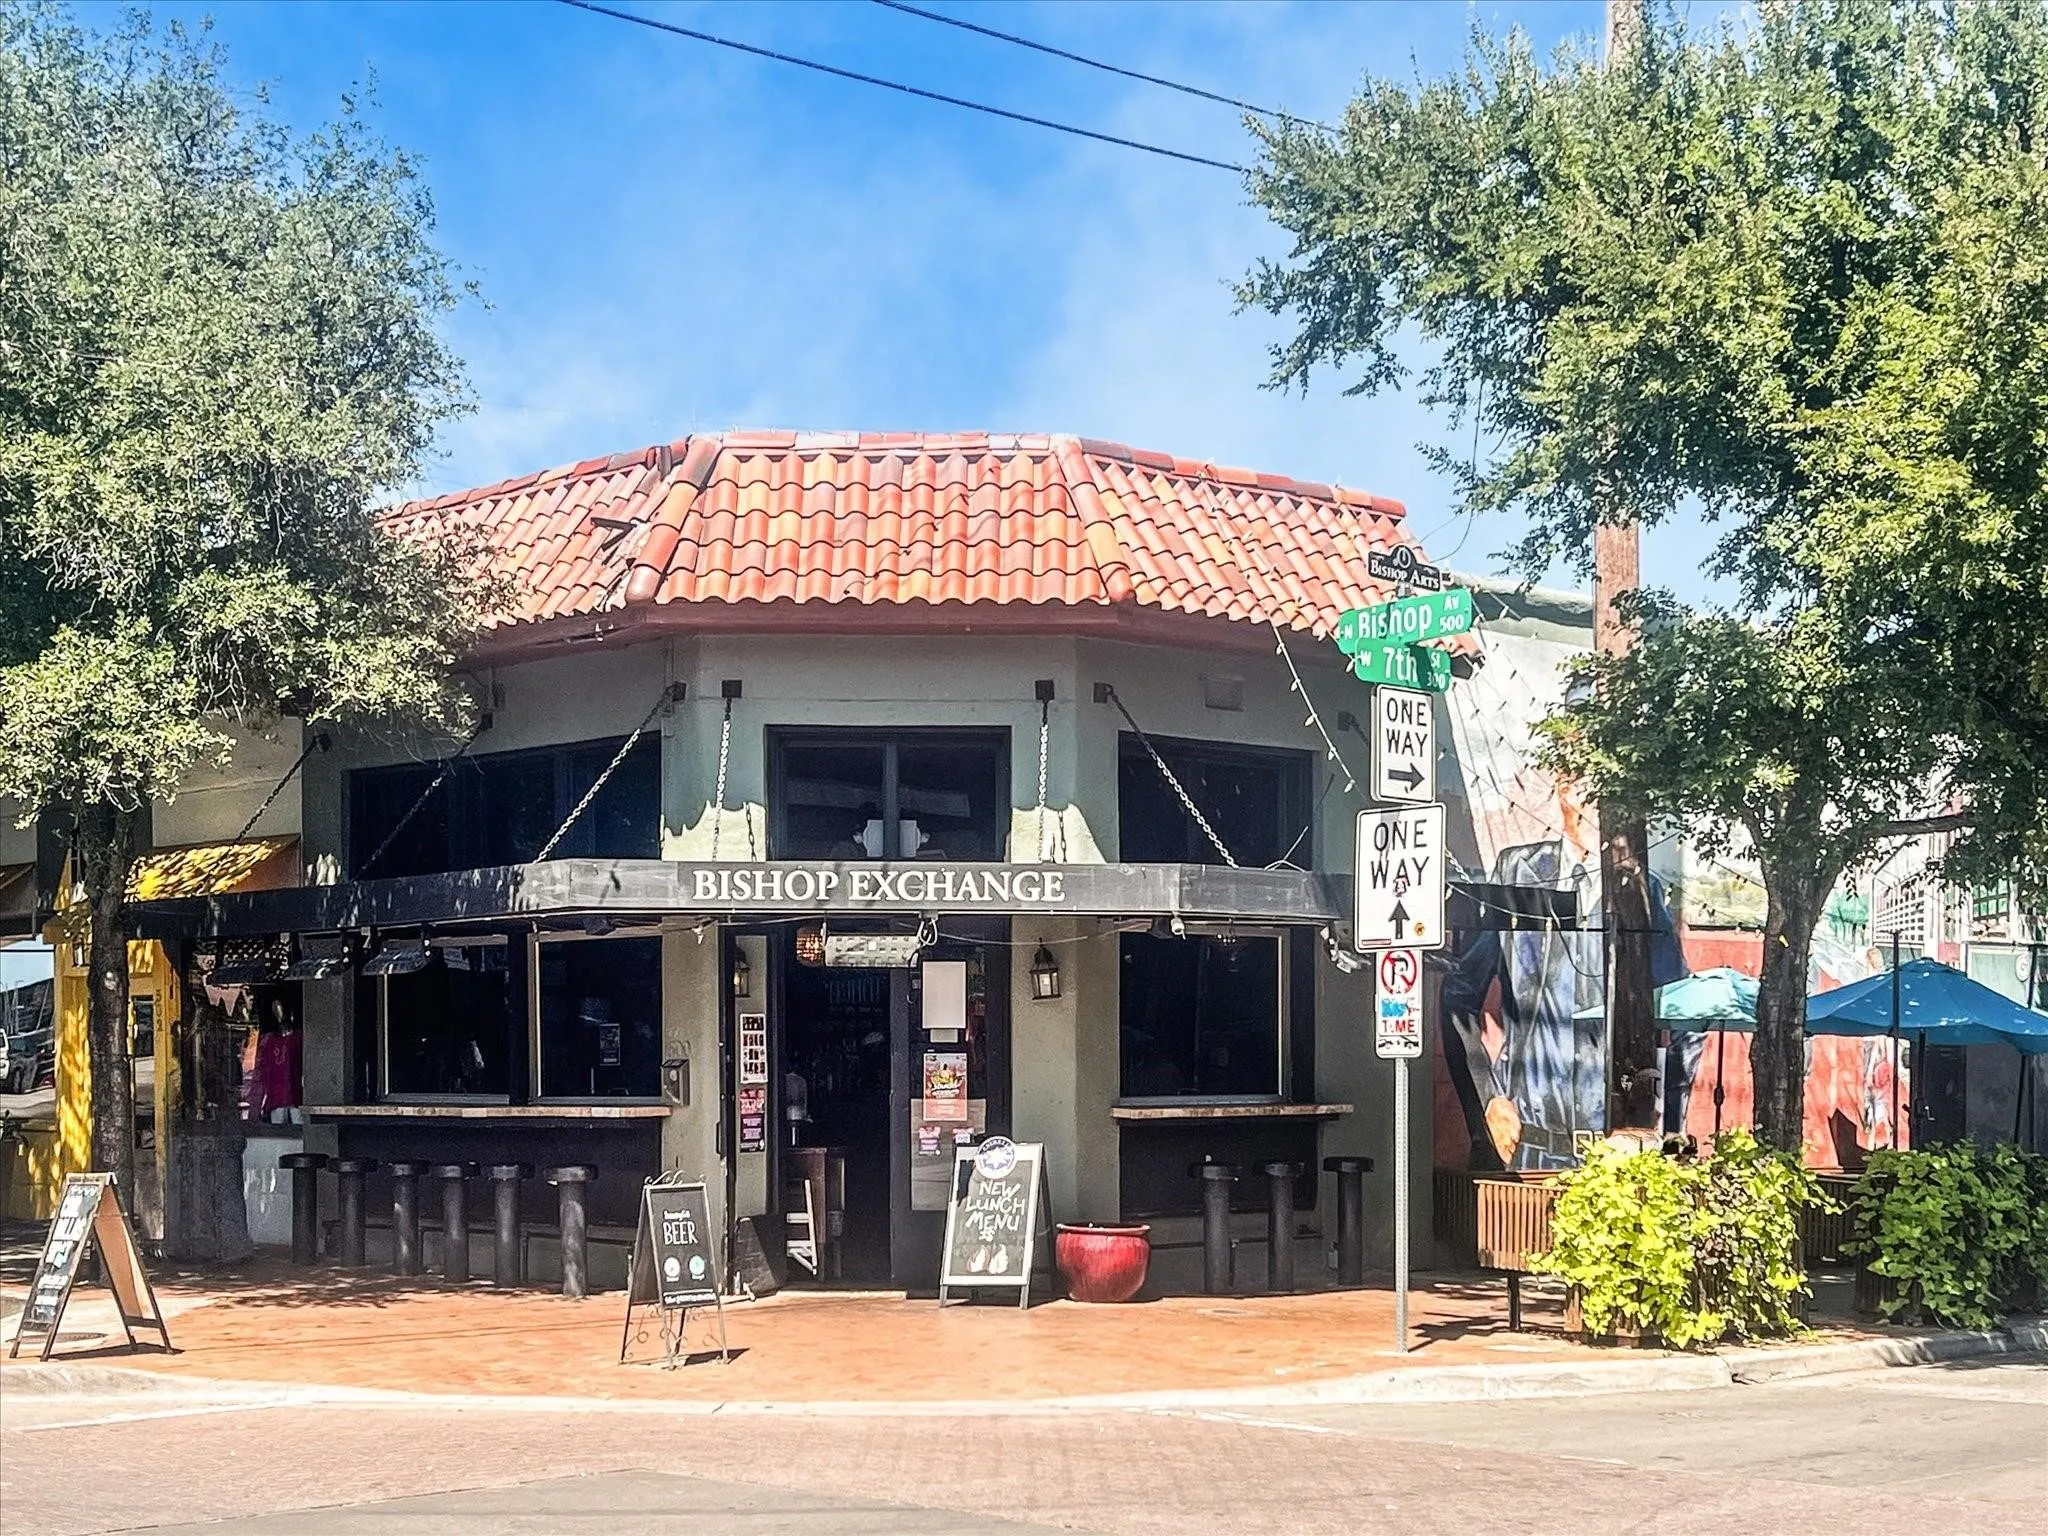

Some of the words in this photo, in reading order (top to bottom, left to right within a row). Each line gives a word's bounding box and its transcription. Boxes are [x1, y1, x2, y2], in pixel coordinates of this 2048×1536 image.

[1358, 603, 1433, 638] Bishop
[1439, 614, 1465, 633] 500
[1360, 650, 1372, 667] W
[1383, 647, 1418, 683] 7th
[1431, 652, 1441, 668] St
[1386, 697, 1427, 727] ONE
[1386, 728, 1428, 757] WAY
[1374, 819, 1428, 852] ONE
[692, 870, 839, 901] BISHOP
[850, 869, 1065, 902] EXCHANGE
[1370, 856, 1430, 890] WAY
[1381, 1020, 1415, 1034] TME
[979, 1180, 1021, 1198] NEW
[965, 1196, 1025, 1215] LUNCH
[662, 1221, 699, 1245] BEER
[965, 1211, 1020, 1232] MENU
